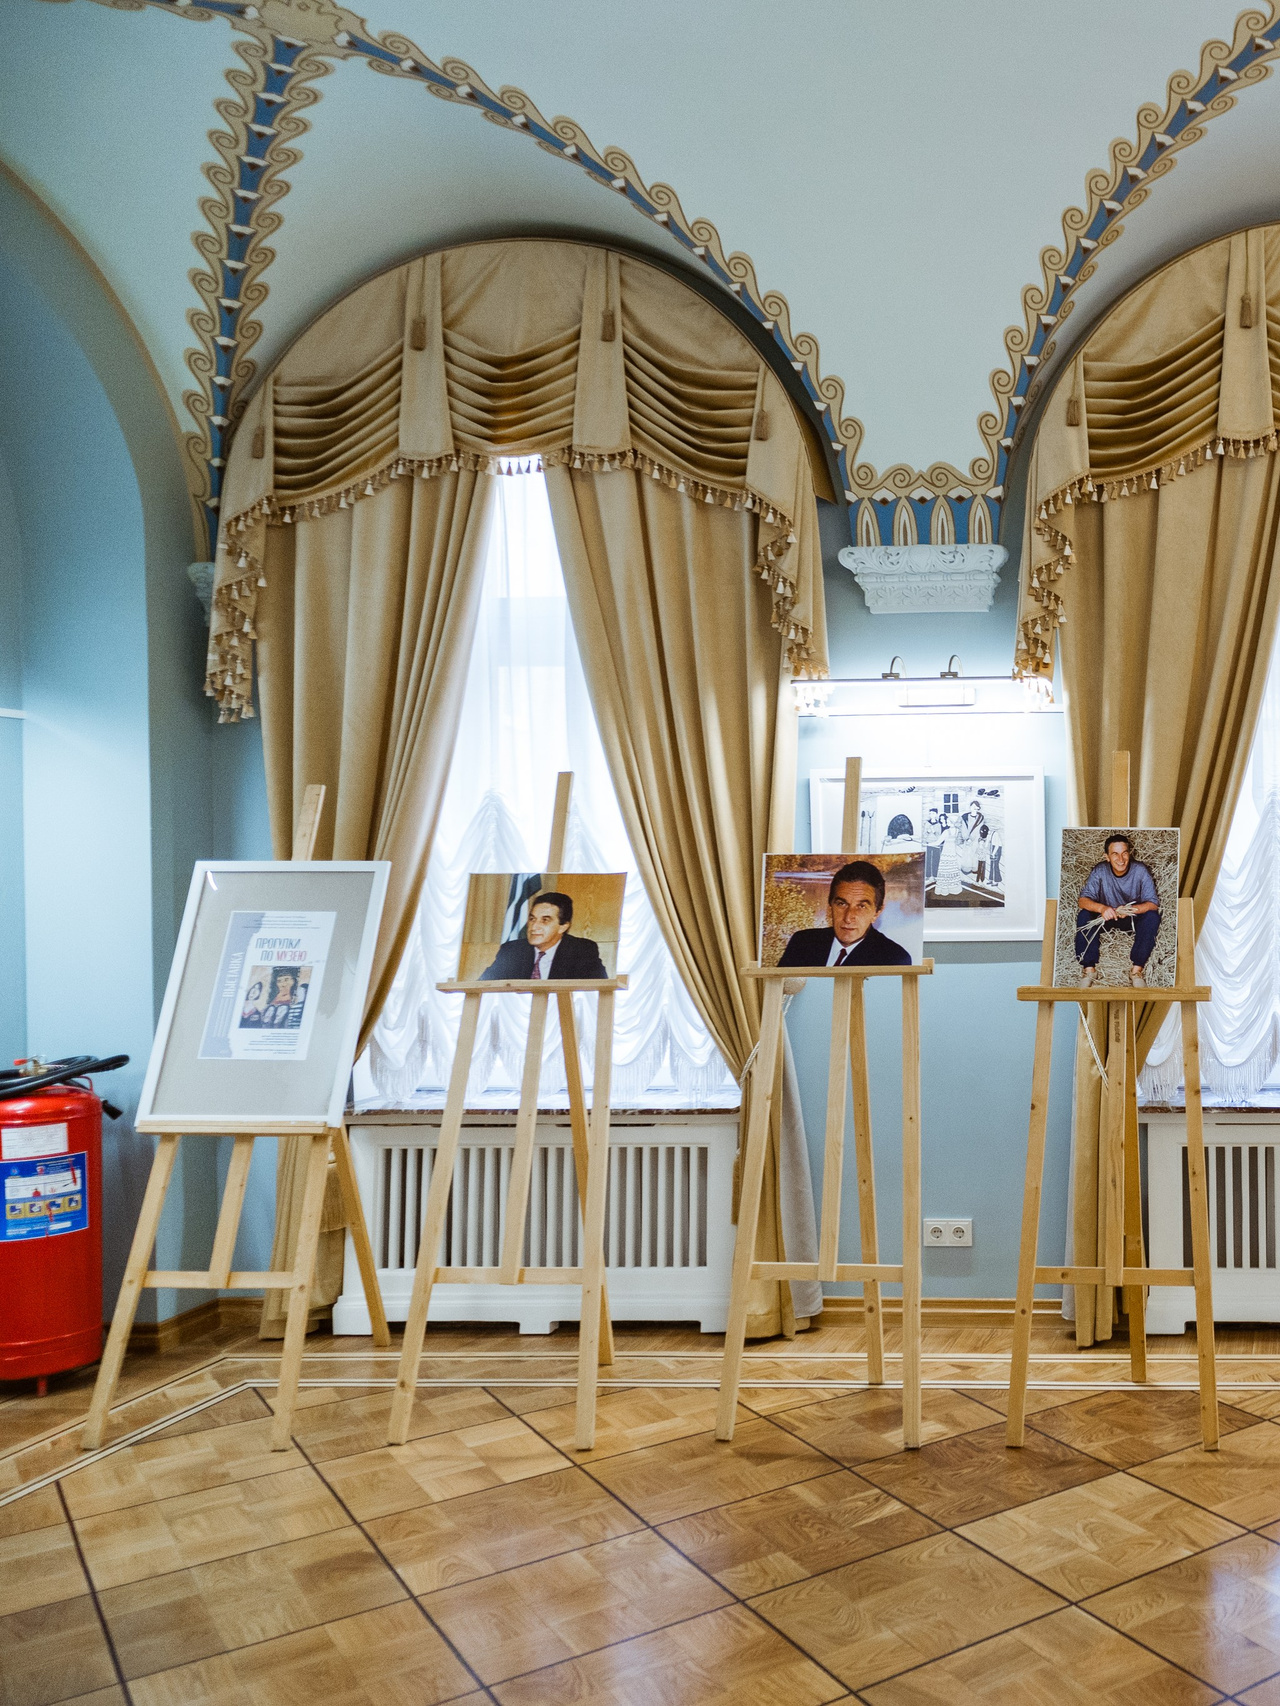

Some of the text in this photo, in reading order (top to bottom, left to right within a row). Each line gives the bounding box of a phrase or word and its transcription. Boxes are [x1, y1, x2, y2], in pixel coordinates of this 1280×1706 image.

[255, 938, 301, 949] ПРОГУЛКИ
[260, 950, 307, 962] ПО МУЗЕЮ
[222, 952, 243, 998] ВЫСТАВКА
